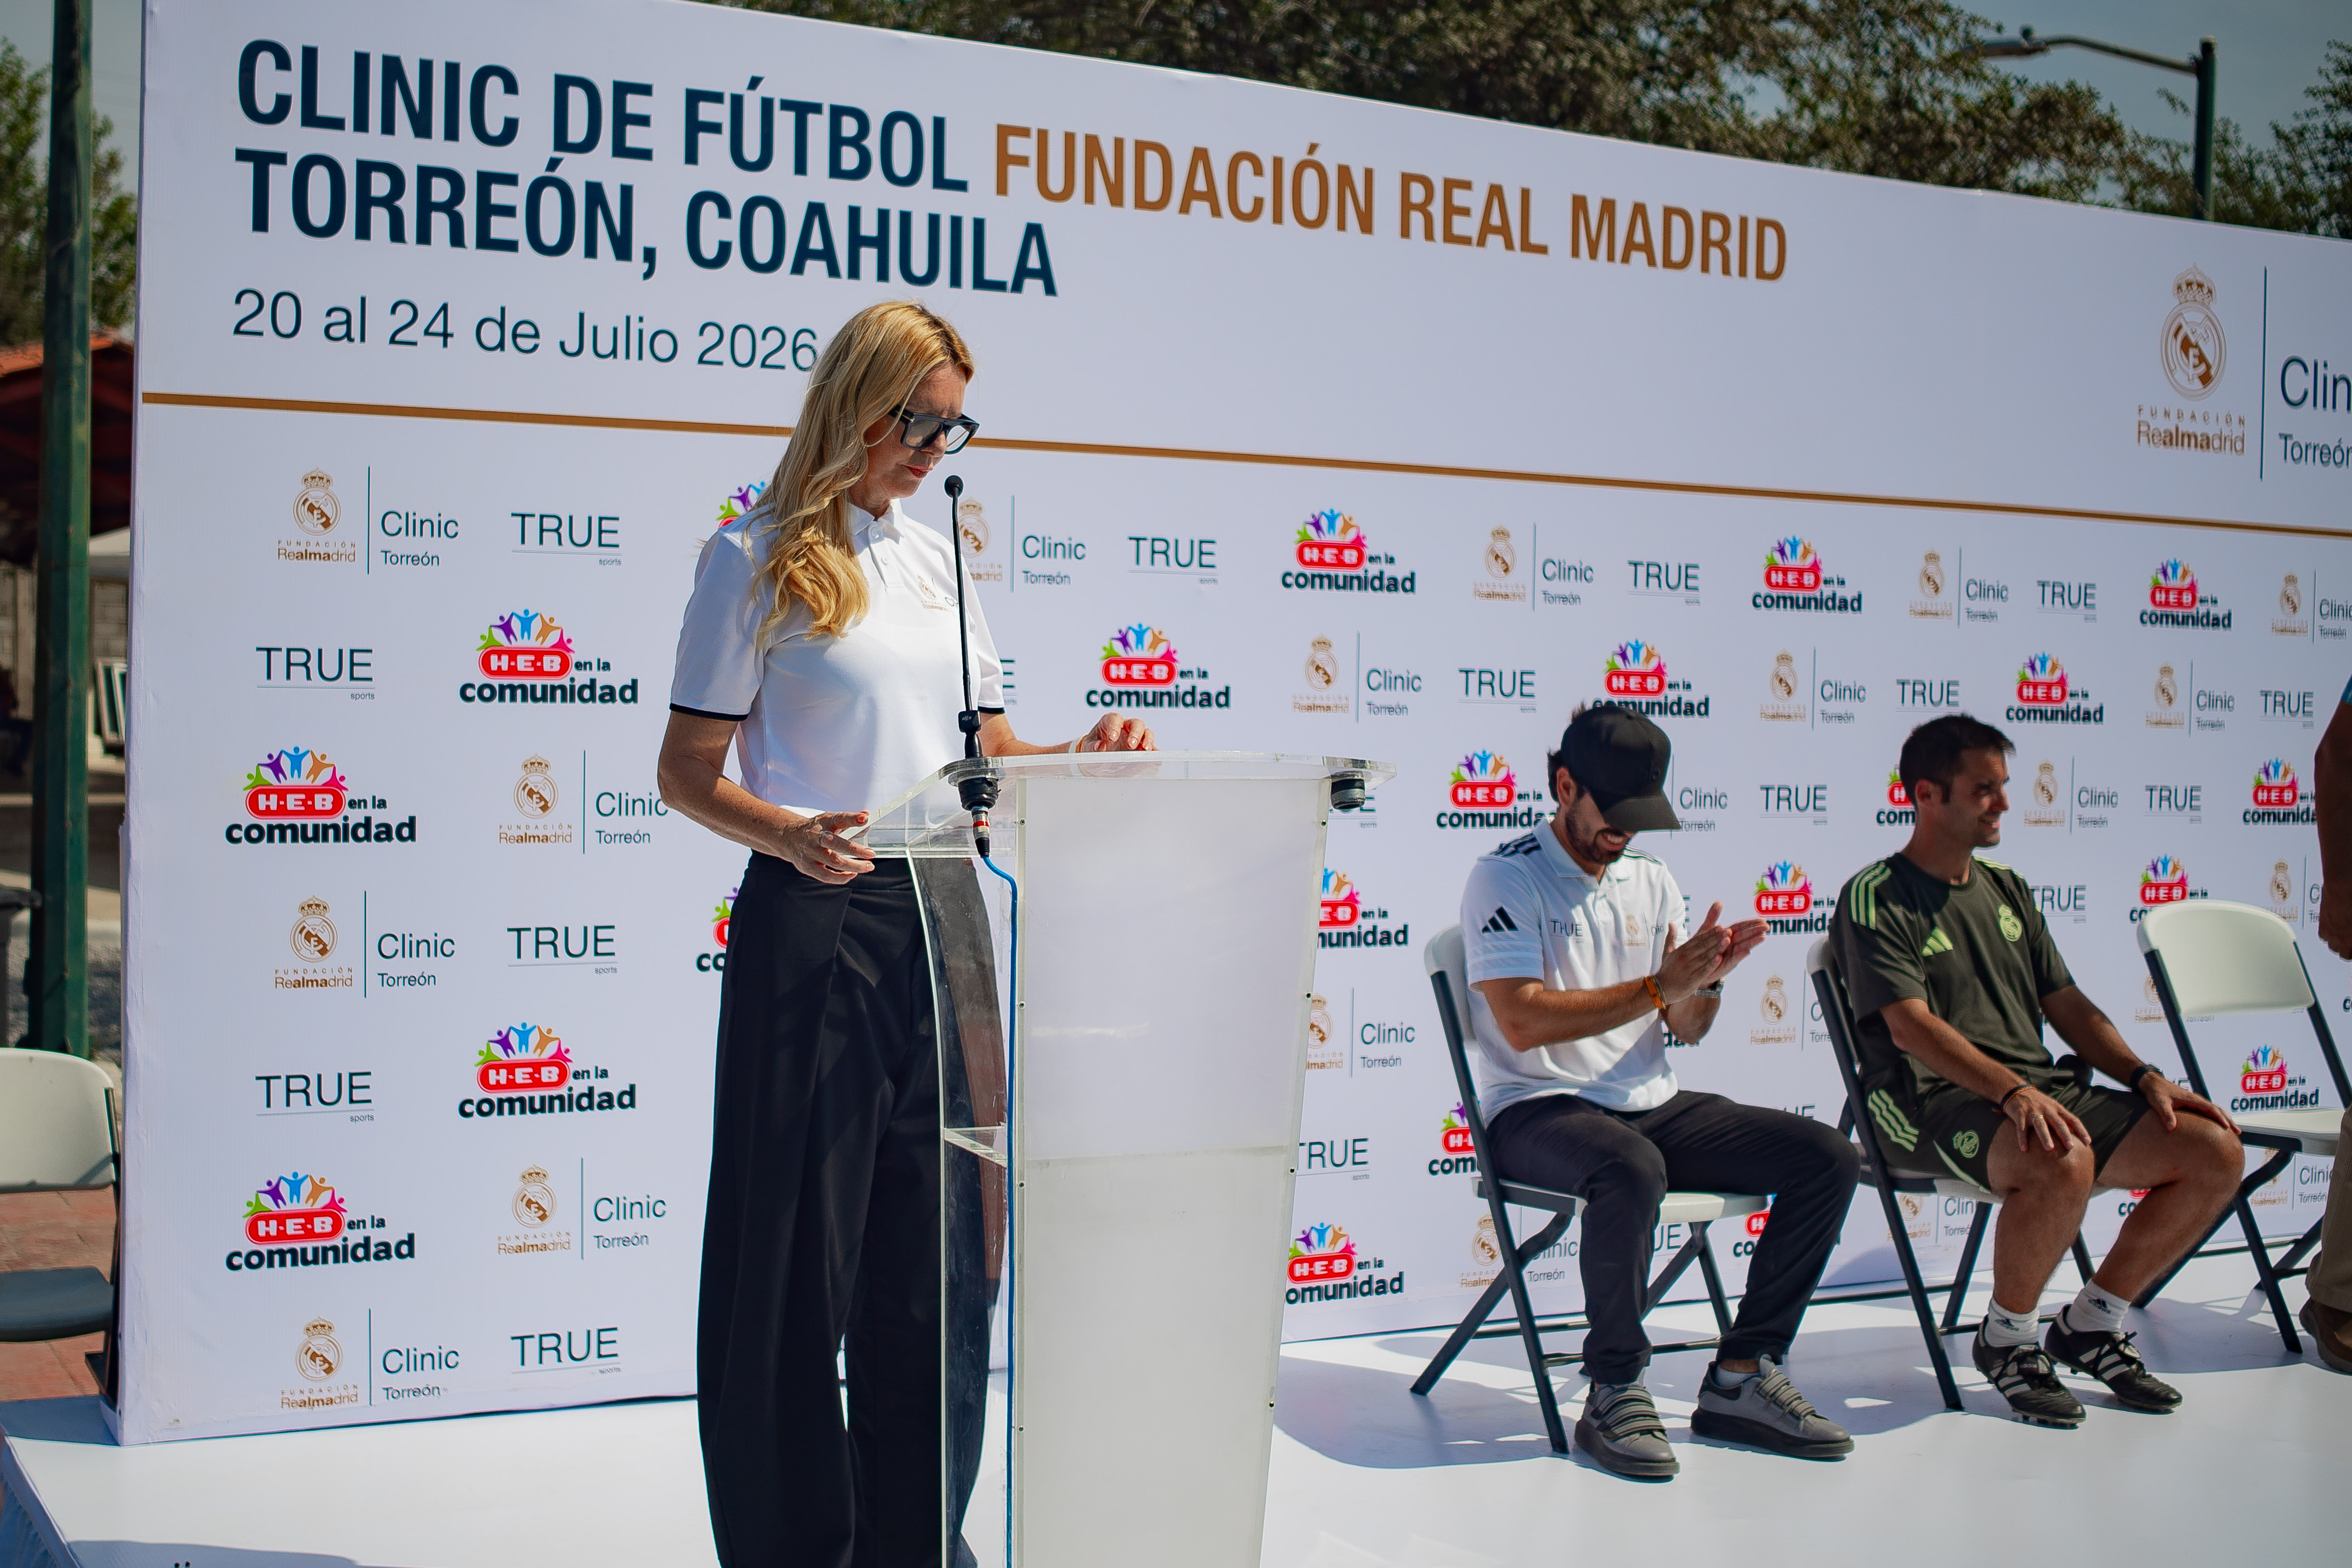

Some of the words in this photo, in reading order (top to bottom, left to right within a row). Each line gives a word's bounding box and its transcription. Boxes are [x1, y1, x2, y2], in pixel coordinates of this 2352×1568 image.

[238, 40, 520, 147] CLINIC
[554, 73, 654, 162] DE
[683, 76, 969, 193] FÚTBOL
[996, 124, 1374, 236] FUNDACIÓN
[1400, 172, 1548, 256] REAL
[1571, 193, 1787, 282] MADRID
[236, 148, 658, 283] TORREÓN,
[685, 190, 1058, 298] COAHUILA
[233, 290, 302, 339] 20
[323, 296, 367, 344] al
[388, 299, 455, 348] 24
[475, 306, 540, 354] de
[559, 311, 679, 365] Julio
[699, 321, 817, 372] 2026
[2281, 356, 2352, 412] Clin
[2138, 405, 2245, 429] FUNDACIÓN
[2138, 419, 2245, 455] Realmadrid
[381, 511, 459, 540] Clinic
[511, 513, 620, 548] TRUE
[278, 540, 355, 550] FUNDACIÓN
[278, 548, 355, 562] Realmadrid
[1022, 535, 1086, 560] Clinic
[1128, 537, 1217, 568] TRUE
[381, 550, 440, 567] Torreón
[599, 558, 621, 567] sports
[1368, 555, 1382, 564] en
[1385, 553, 1395, 564] la
[1022, 571, 1071, 586] Torreón
[1281, 570, 1415, 593] comunidad
[1542, 558, 1593, 583] Clinic
[1628, 560, 1700, 591] TRUE
[1542, 590, 1581, 605] Torreón
[1752, 589, 1862, 613] comunidad
[1966, 579, 2009, 603] Clinic
[2037, 580, 2097, 610] TRUE
[2140, 608, 2232, 630] comunidad
[256, 648, 373, 682] TRUE
[574, 662, 590, 671] en
[597, 658, 611, 671] la
[1180, 670, 1193, 679] en
[1197, 668, 1207, 679] la
[459, 677, 638, 704] comunidad
[1367, 668, 1422, 693] Clinic
[1458, 669, 1536, 698] TRUE
[1821, 680, 1866, 703] Clinic
[350, 692, 375, 701] sports
[1086, 684, 1230, 708] comunidad
[1897, 680, 1959, 707] TRUE
[2196, 690, 2235, 713] Clinic
[2260, 690, 2314, 718] TRUE
[1367, 702, 1408, 715] Torreón
[1820, 710, 1855, 724] Torreón
[2006, 703, 2104, 724] comunidad
[348, 799, 367, 809] en
[372, 796, 387, 809] la
[595, 790, 669, 817] Clinic
[1533, 790, 1543, 801] la
[1680, 787, 1728, 810] Clinic
[1760, 785, 1827, 812] TRUE
[2078, 786, 2118, 808] Clinic
[2146, 785, 2201, 812] TRUE
[225, 816, 416, 844] comunidad
[499, 831, 572, 844] Realmadrid
[595, 830, 650, 844] Torreón
[1362, 910, 1375, 919] en
[1379, 908, 1388, 918] la
[377, 933, 455, 959] Clinic
[507, 925, 616, 959] TRUE
[274, 966, 353, 975] FUNDACIÓN
[377, 971, 436, 987] Torreón
[594, 966, 617, 974] sports
[275, 975, 353, 989] Realmadrid
[1360, 1022, 1415, 1045] Clinic
[1751, 1034, 1795, 1045] Realmadrid
[572, 1069, 591, 1080] en
[595, 1066, 609, 1079] la
[1360, 1055, 1401, 1068] Torreón
[255, 1072, 372, 1108] TRUE
[458, 1084, 636, 1118] comunidad
[2231, 1087, 2319, 1111] comunidad
[349, 1113, 374, 1123] sports
[594, 1196, 666, 1222] Clinic
[1944, 1197, 1973, 1216] Clin
[347, 1219, 366, 1230] en
[371, 1215, 386, 1229] la
[226, 1234, 415, 1271] comunidad
[498, 1237, 570, 1255] Realmadrid
[593, 1233, 649, 1249] Torreón
[1357, 1260, 1371, 1270] en
[1374, 1257, 1384, 1268] la
[1527, 1268, 1565, 1282] Torreón
[1286, 1271, 1404, 1305] omunidad
[511, 1327, 619, 1366] TRUE
[383, 1346, 459, 1374] Clinic
[281, 1390, 358, 1409] Realmadrid
[382, 1383, 440, 1400] Torreón
